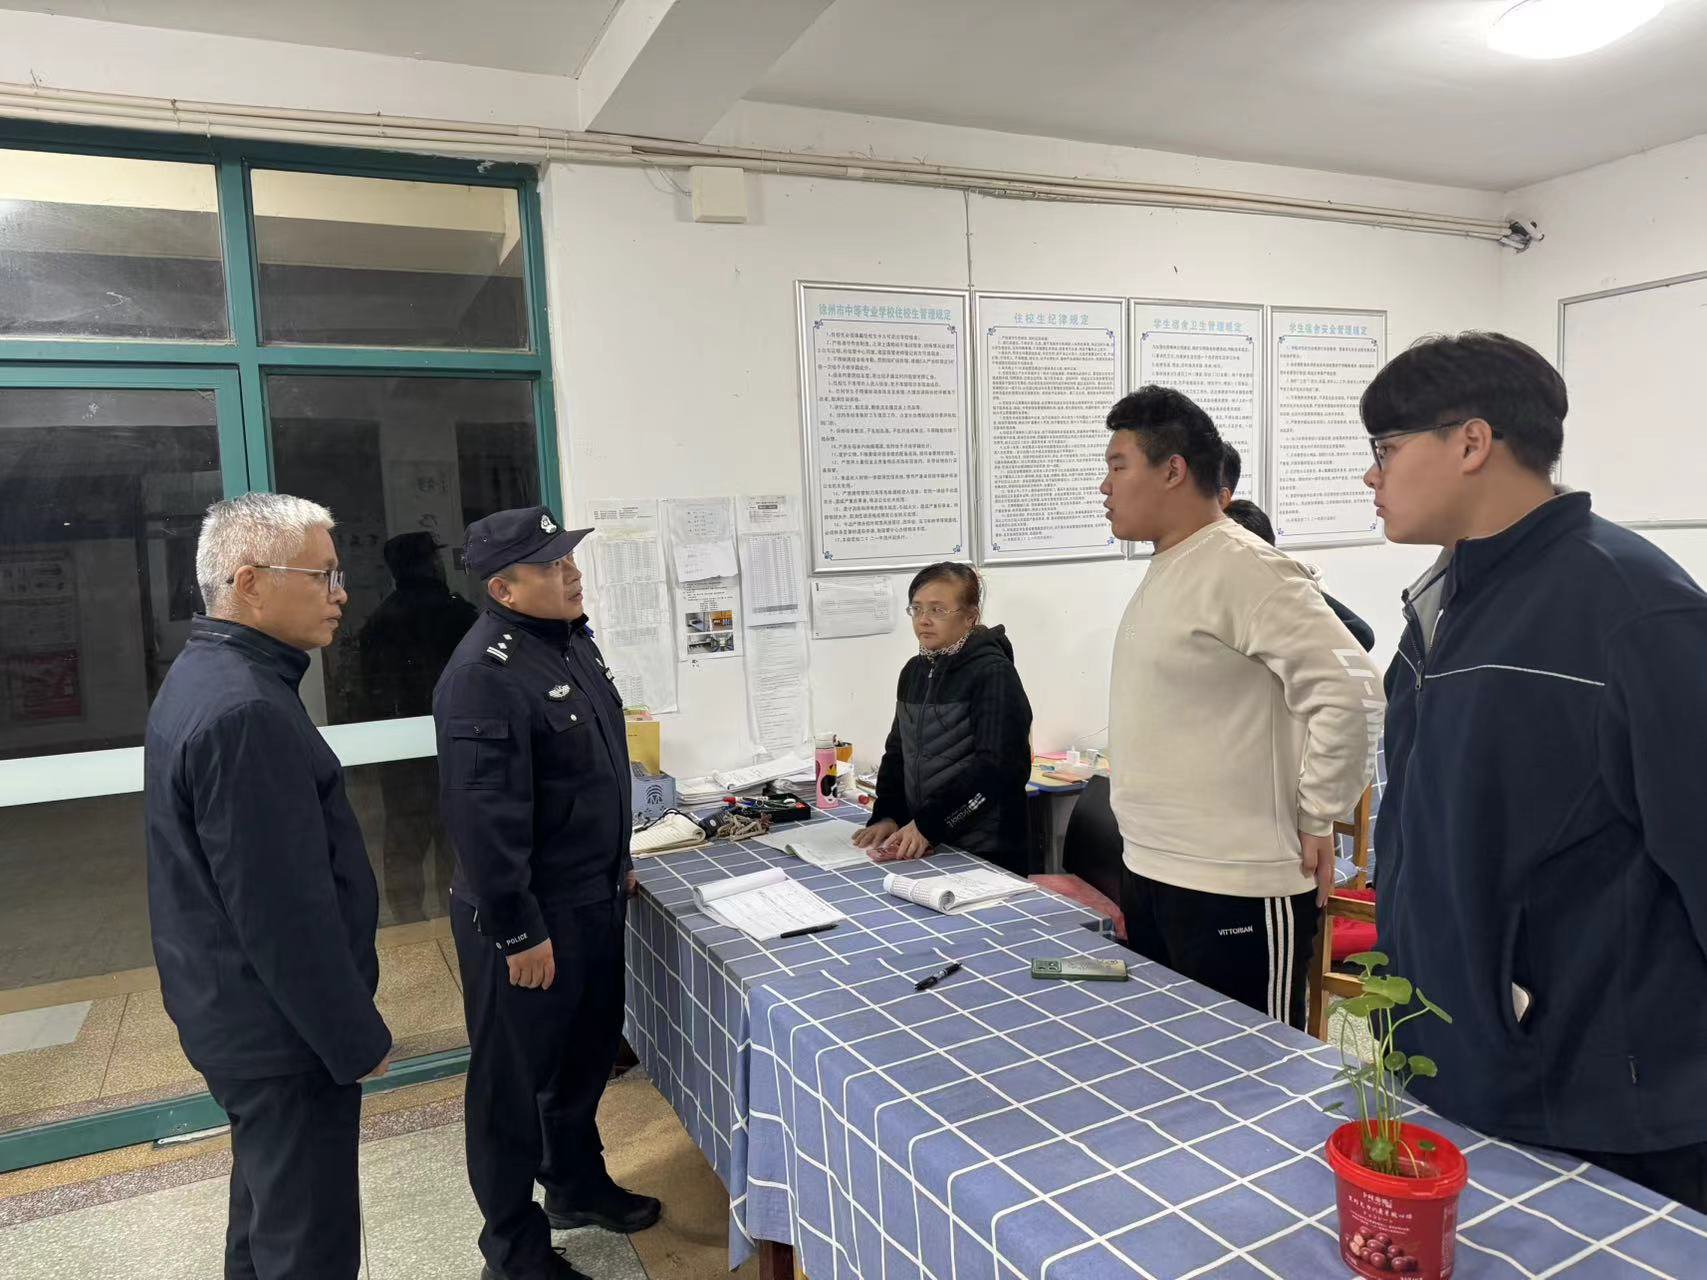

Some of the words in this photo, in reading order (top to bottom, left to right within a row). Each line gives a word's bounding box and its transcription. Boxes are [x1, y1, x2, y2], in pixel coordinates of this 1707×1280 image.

[818, 304, 952, 320] 徐州市中等专业学校住校生管理规定
[1014, 312, 1089, 326] 住校生纪律规定
[1153, 318, 1242, 332] 学生宿舍卫生管理规定
[1288, 321, 1367, 336] 学生宿舍安全管理规定
[1217, 924, 1254, 937] VITTORIAN
[506, 933, 528, 946] POLICE
